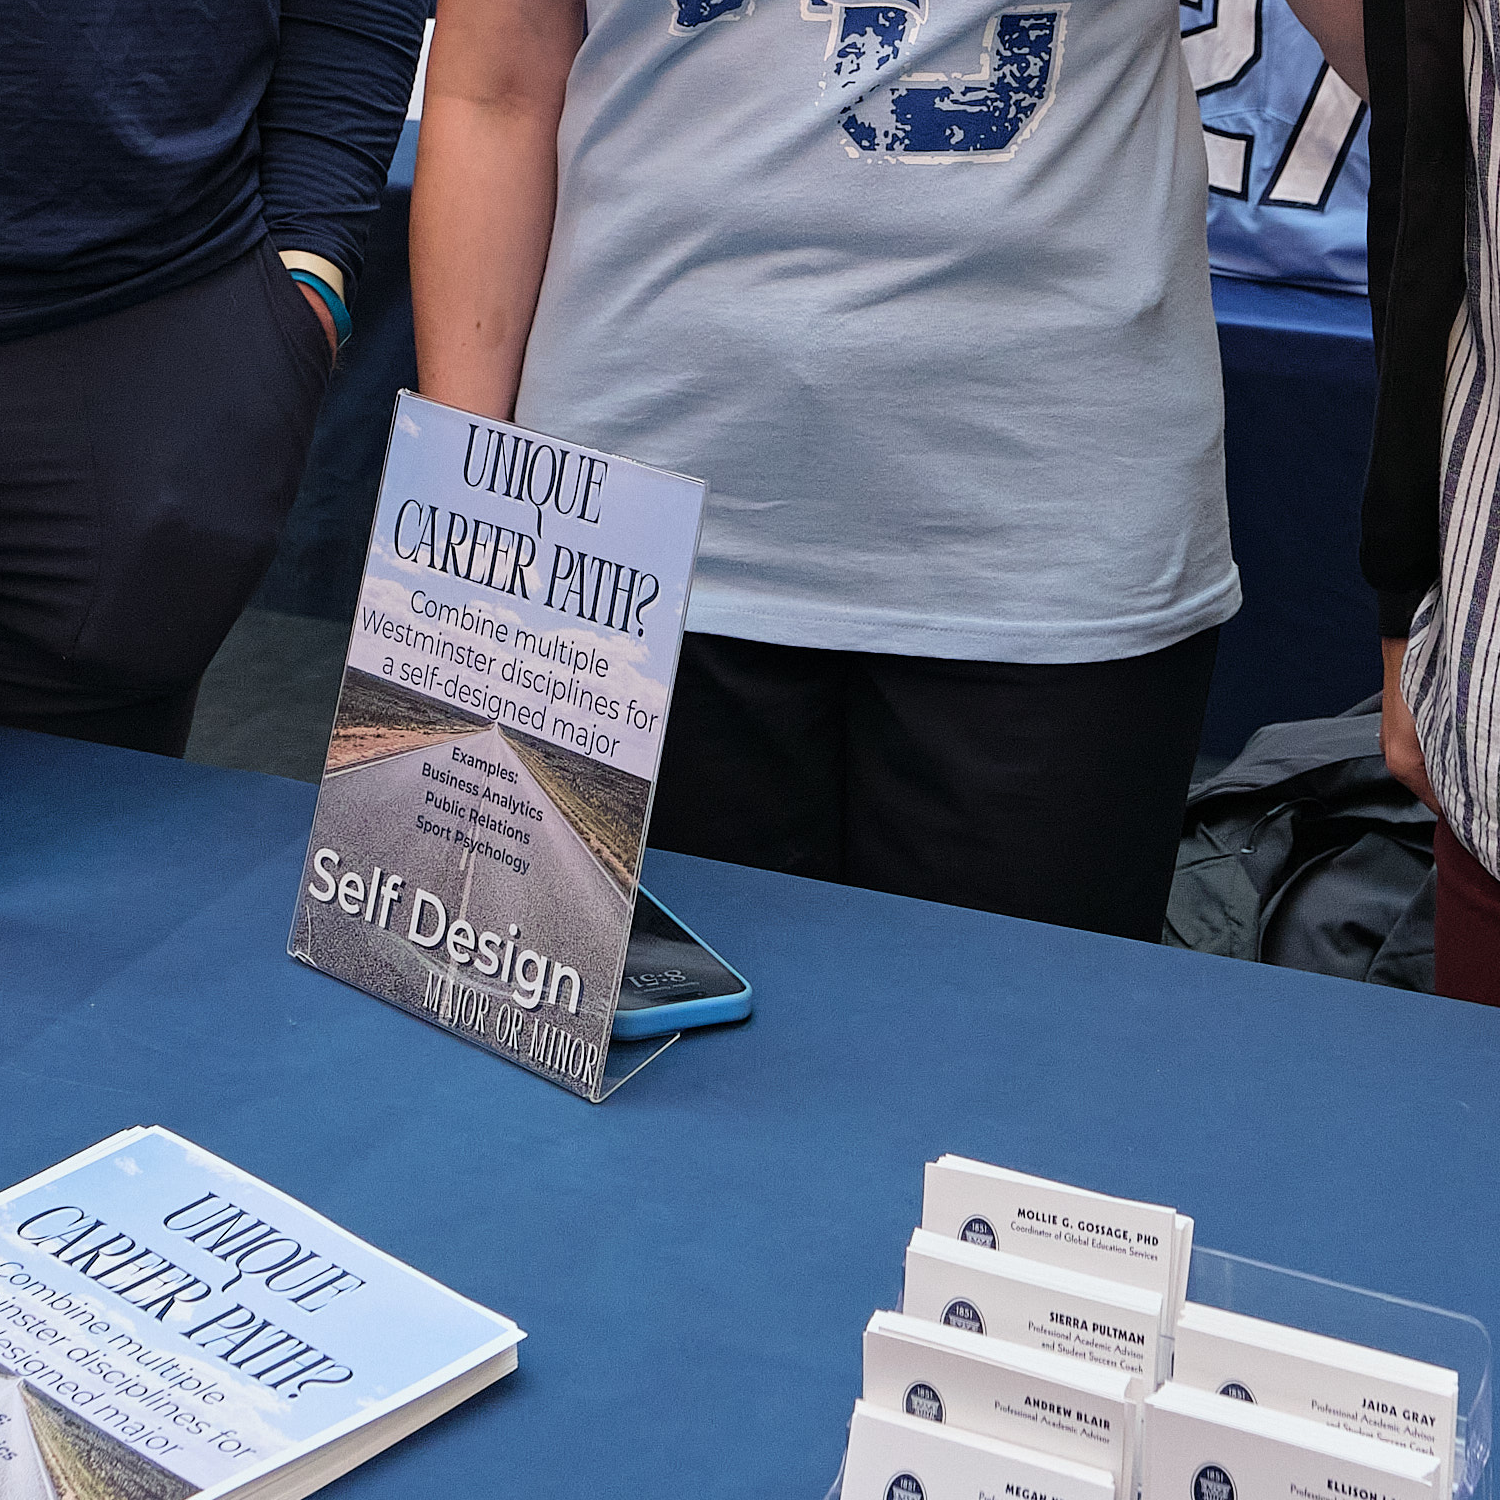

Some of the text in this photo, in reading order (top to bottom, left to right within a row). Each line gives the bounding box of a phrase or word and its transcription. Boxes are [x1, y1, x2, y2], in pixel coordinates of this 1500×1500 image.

[463, 423, 609, 537] UNIQUE
[394, 499, 660, 638] CAREER PATH?
[410, 590, 609, 678] Combine multiple
[363, 606, 659, 733] Westminster disciplines for
[382, 656, 621, 758] a self-designed major
[421, 762, 544, 822] Business Analytics
[451, 746, 519, 785] Examples:
[415, 814, 531, 876] Sport Psychology
[424, 790, 531, 845] Public Relations
[308, 847, 582, 1013] Self Design
[625, 969, 687, 988] 8:51
[423, 970, 598, 1085] MAJOR OR MINOR
[163, 1191, 366, 1312] UNIQUE
[1010, 1220, 1158, 1262] Coordinator of Global Education Services
[1017, 1207, 1159, 1247] MOLLIE G. GOSSAGE, PHD
[16, 1205, 354, 1399] CAREER PATH?
[1049, 1311, 1145, 1346] SIERRA PULTMAN
[107, 1333, 225, 1403] multiple
[66, 1347, 211, 1435] disciplines
[207, 1430, 256, 1458] for
[93, 1404, 184, 1456] major
[1024, 1395, 1110, 1431] ANDREW BLAIR
[1362, 1398, 1436, 1427] JAIDA GRAY
[1327, 1479, 1377, 1500] ELLISON
